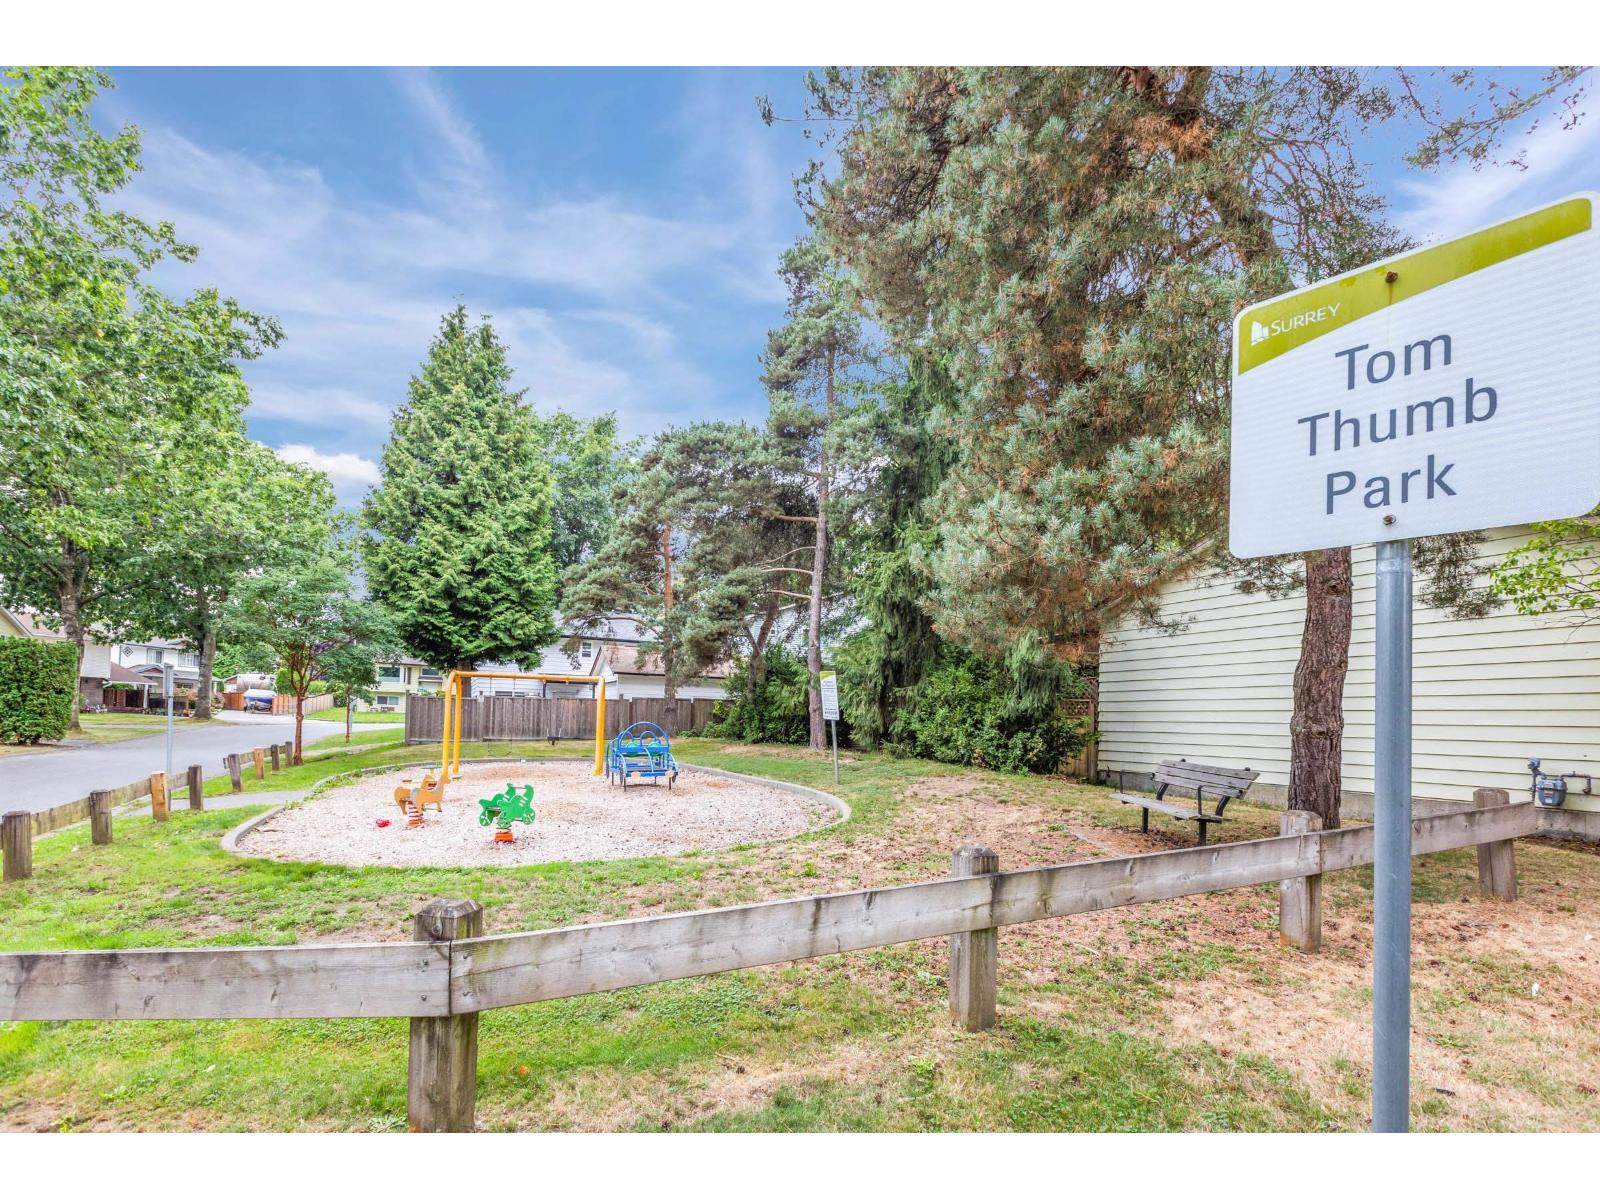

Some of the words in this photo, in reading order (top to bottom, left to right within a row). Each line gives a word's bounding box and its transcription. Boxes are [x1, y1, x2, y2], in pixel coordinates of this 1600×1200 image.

[1271, 303, 1341, 336] SURREY
[1335, 334, 1452, 390] Tom
[1298, 377, 1498, 456] Thumb
[1326, 454, 1457, 515] Park
